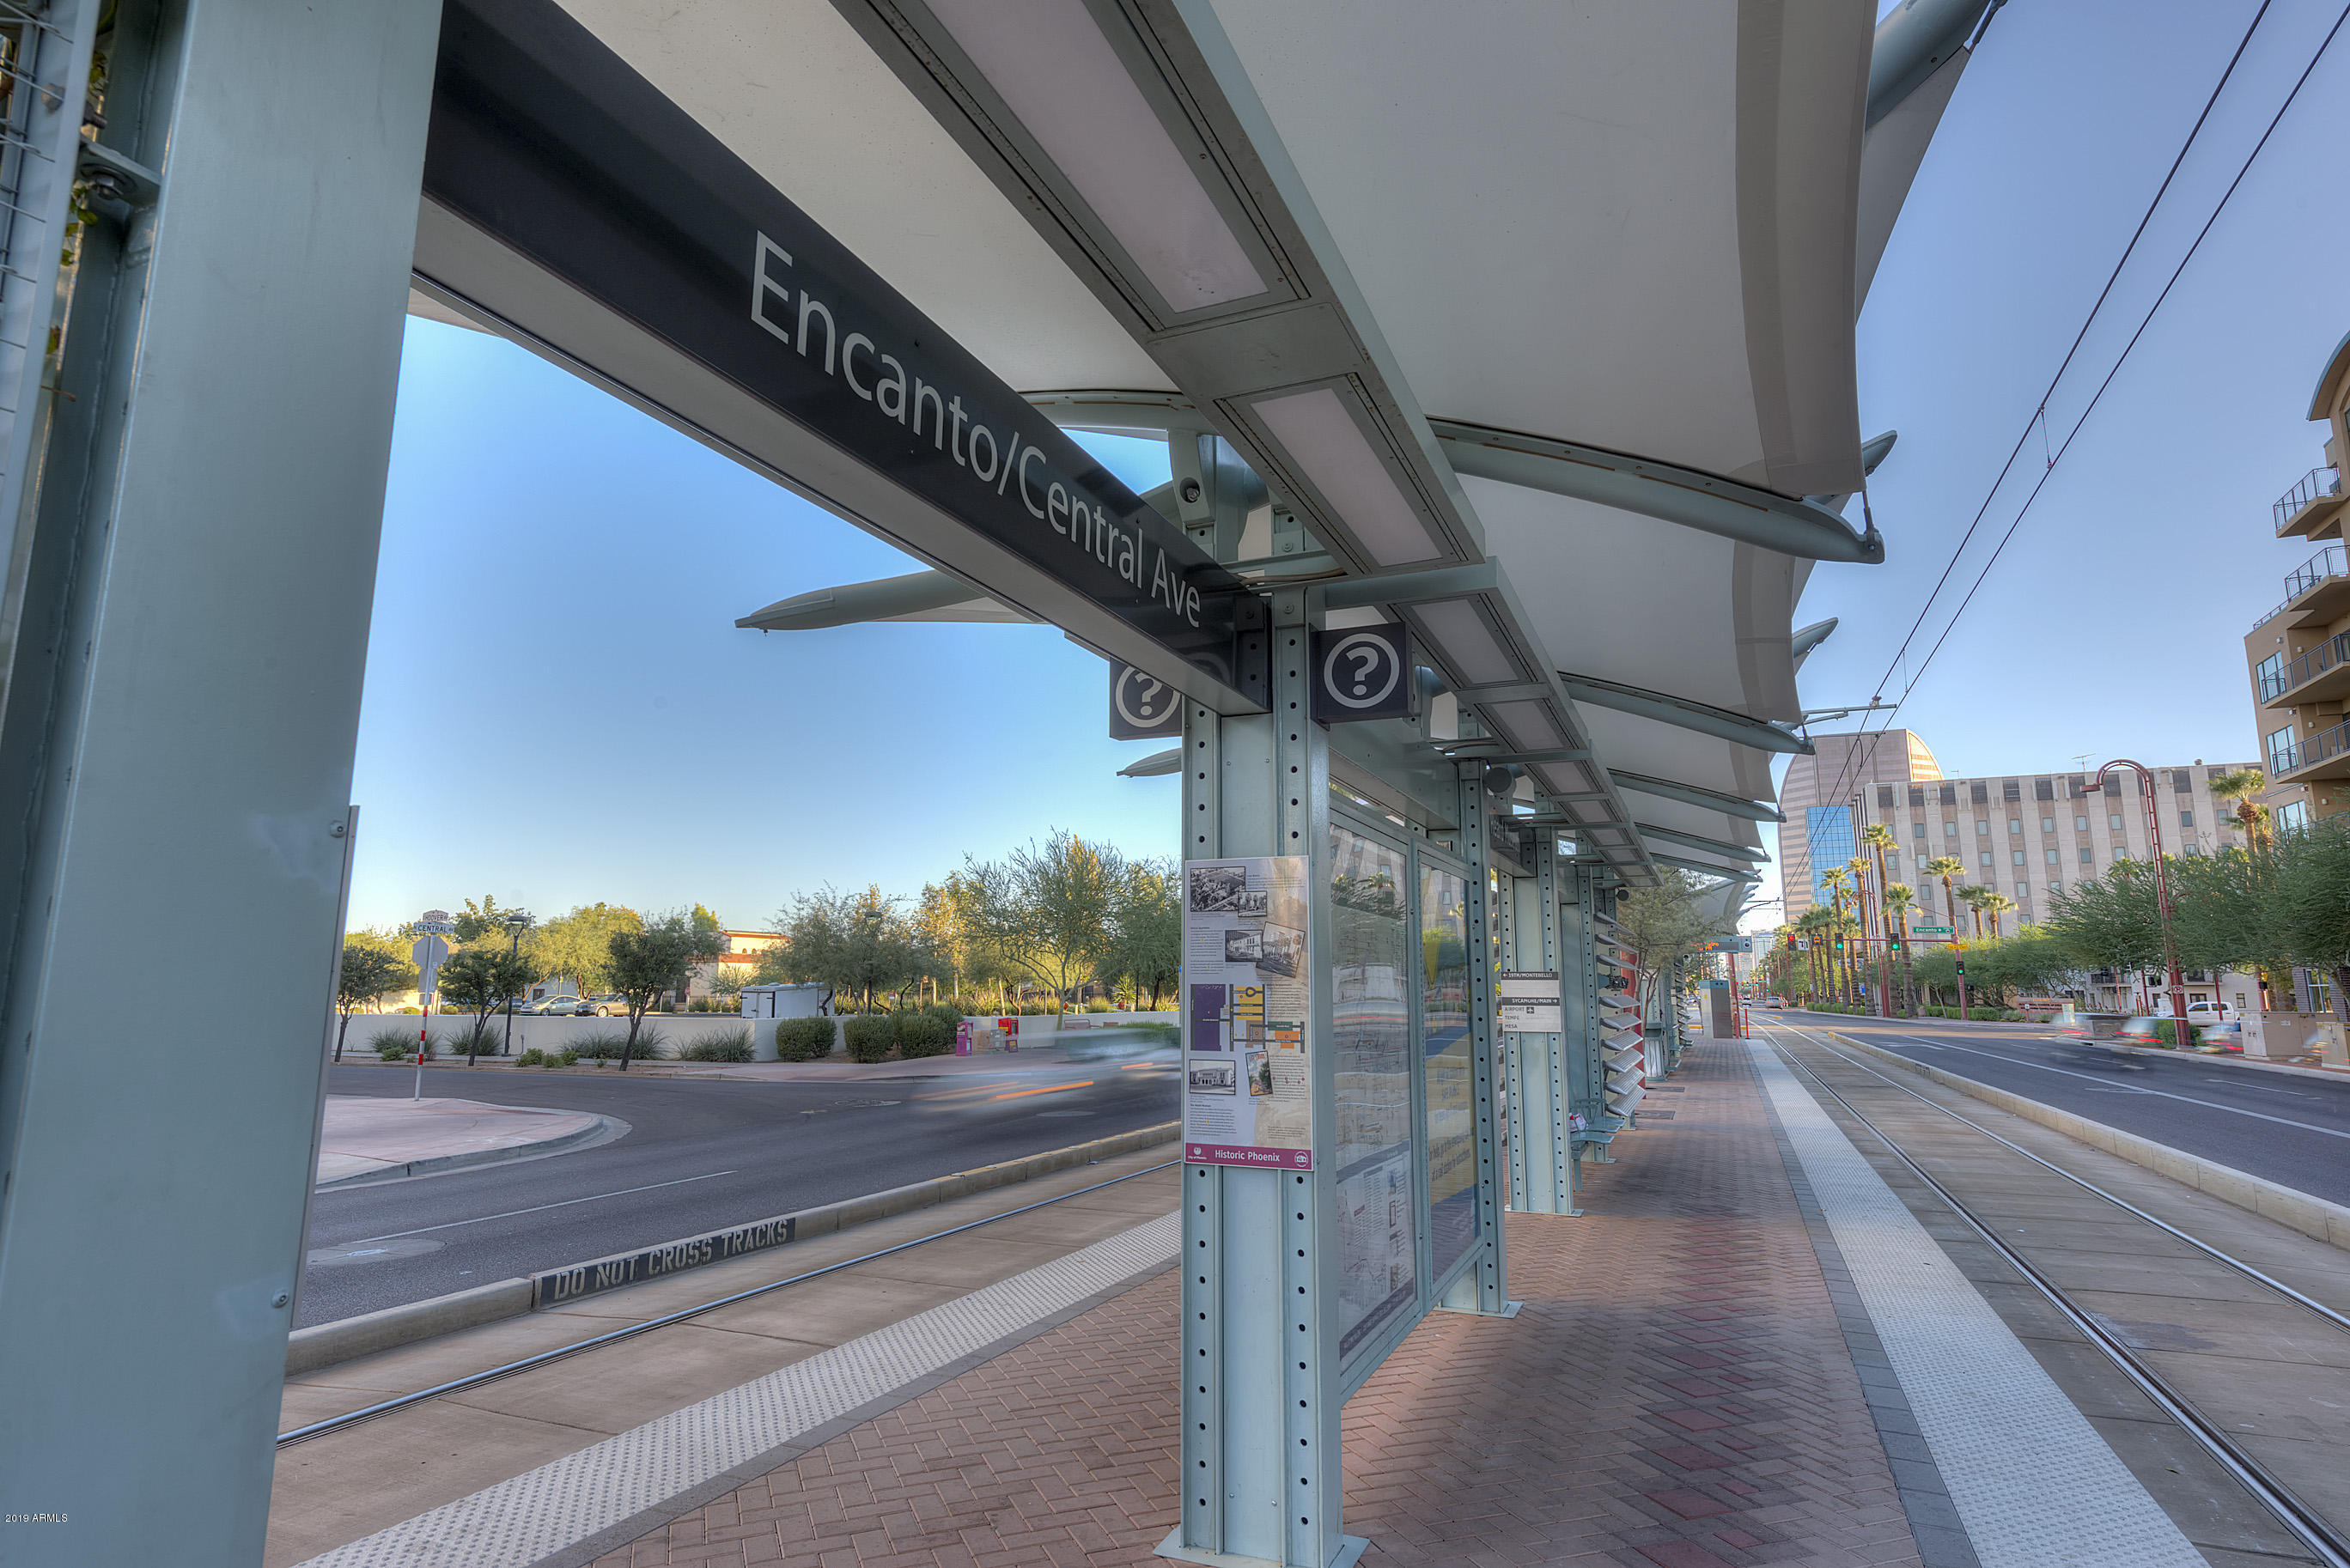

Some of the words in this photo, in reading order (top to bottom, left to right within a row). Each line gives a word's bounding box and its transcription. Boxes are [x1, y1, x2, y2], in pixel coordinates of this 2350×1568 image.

[750, 229, 1144, 590] Encanto/Central
[1150, 546, 1202, 629] Ave
[1215, 1149, 1245, 1160] Historic
[1247, 1151, 1281, 1162] Phoenix
[554, 1267, 586, 1300] DO
[596, 1255, 640, 1289] NOT
[648, 1238, 714, 1276] CROSS
[721, 1219, 788, 1258] TRACKS
